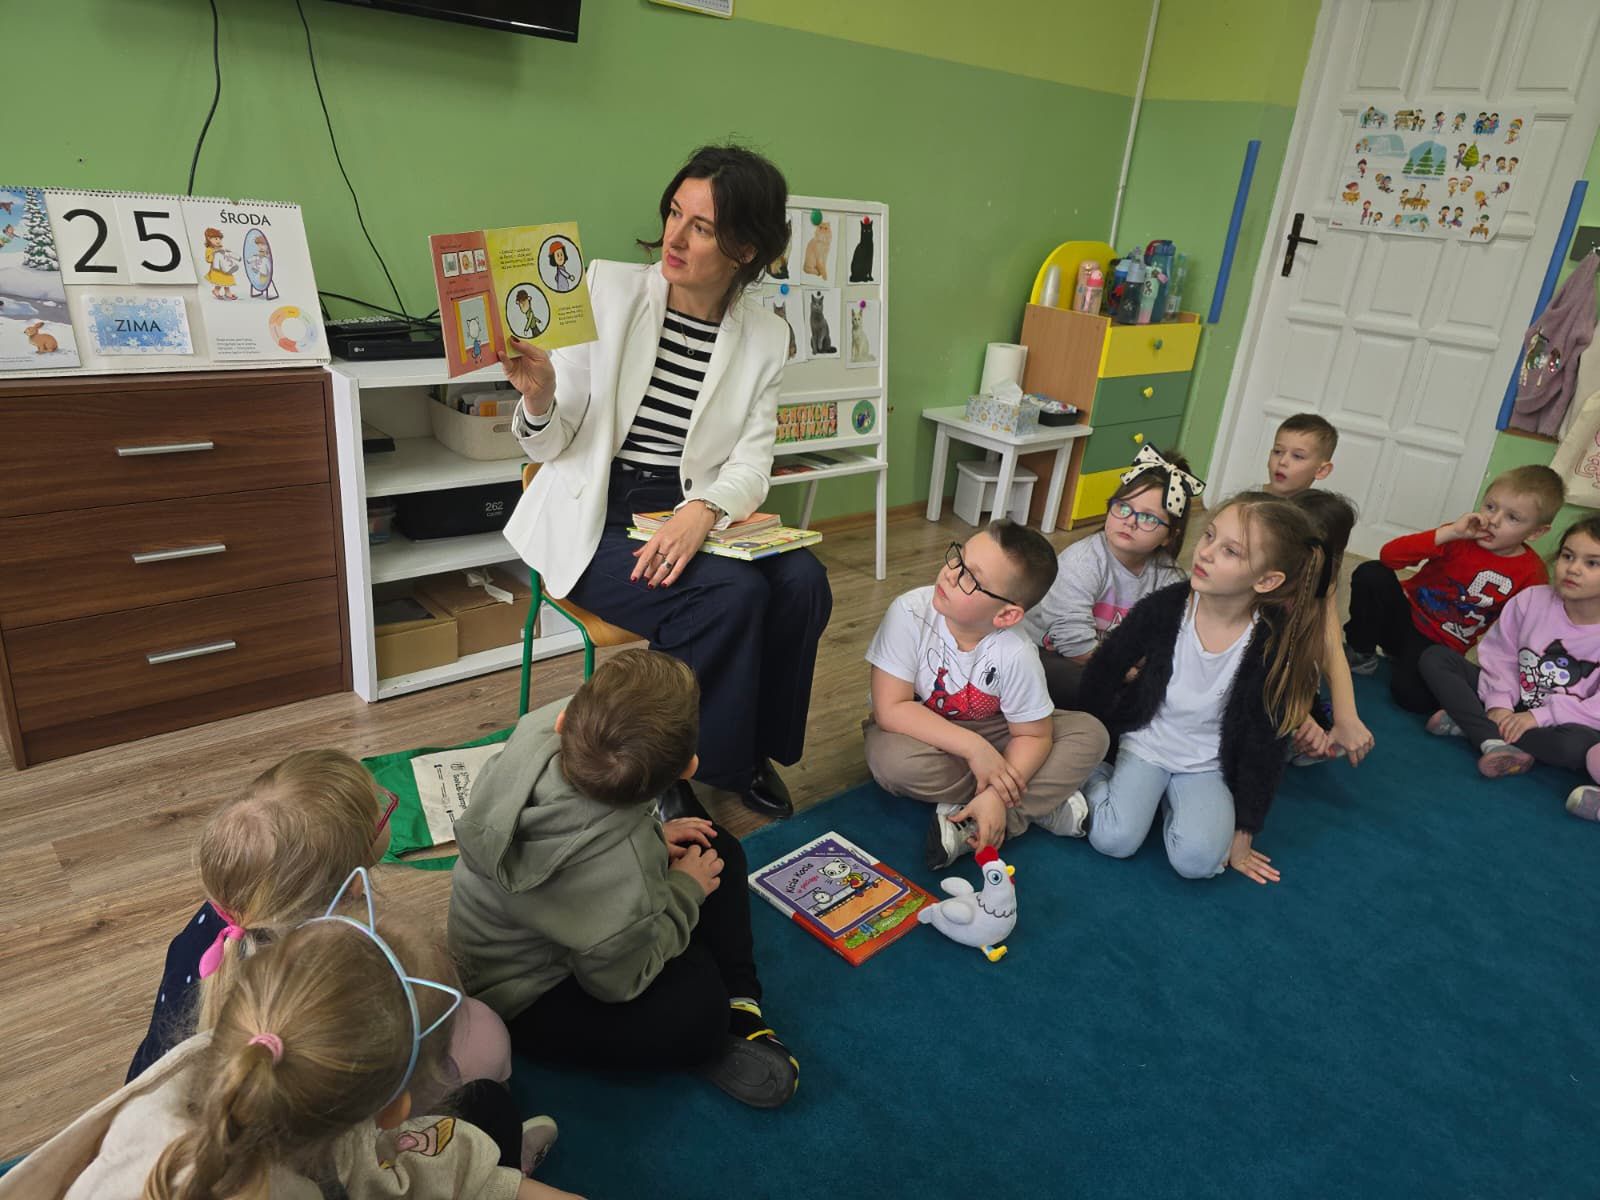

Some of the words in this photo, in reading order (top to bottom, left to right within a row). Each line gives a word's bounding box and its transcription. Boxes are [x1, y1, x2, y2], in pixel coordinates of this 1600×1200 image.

[219, 208, 272, 227] ŚRODA
[114, 318, 162, 333] ZIMA
[485, 501, 504, 511] 262
[785, 878, 799, 894] Kicia
[793, 863, 814, 879] Kocia
